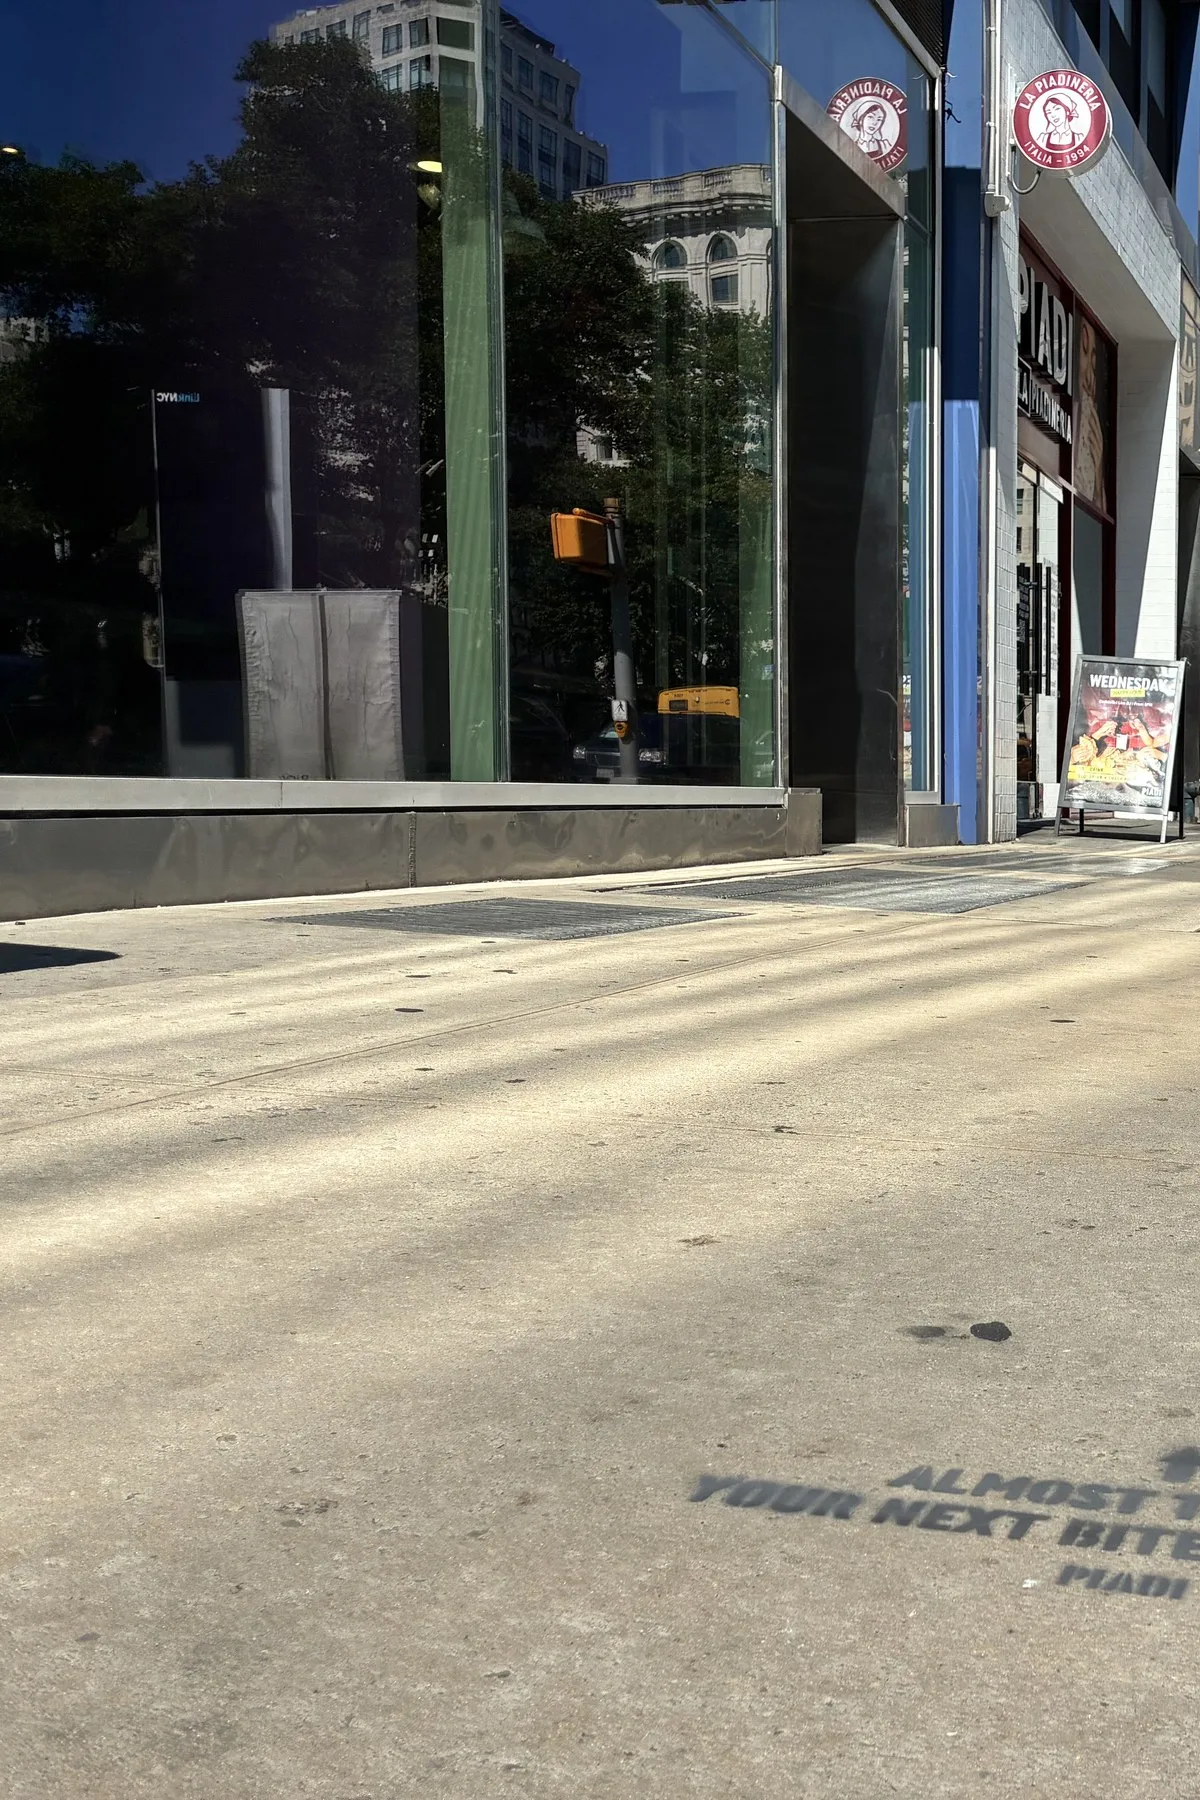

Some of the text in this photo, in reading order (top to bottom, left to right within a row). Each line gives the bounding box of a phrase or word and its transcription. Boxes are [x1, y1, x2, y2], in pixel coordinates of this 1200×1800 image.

[1019, 73, 1102, 112] LA PIADINERIA
[1024, 140, 1053, 165] ITALIA
[1064, 144, 1091, 164] 1994
[1018, 256, 1073, 396] PIADI
[1031, 381, 1072, 445] PIADINERIA
[1090, 674, 1168, 692] WEDNESDAY
[690, 1474, 862, 1520] YOUR
[872, 1498, 1052, 1540] NEXT
[887, 1465, 1158, 1514] ALMOST
[1055, 1565, 1189, 1600] PIADI
